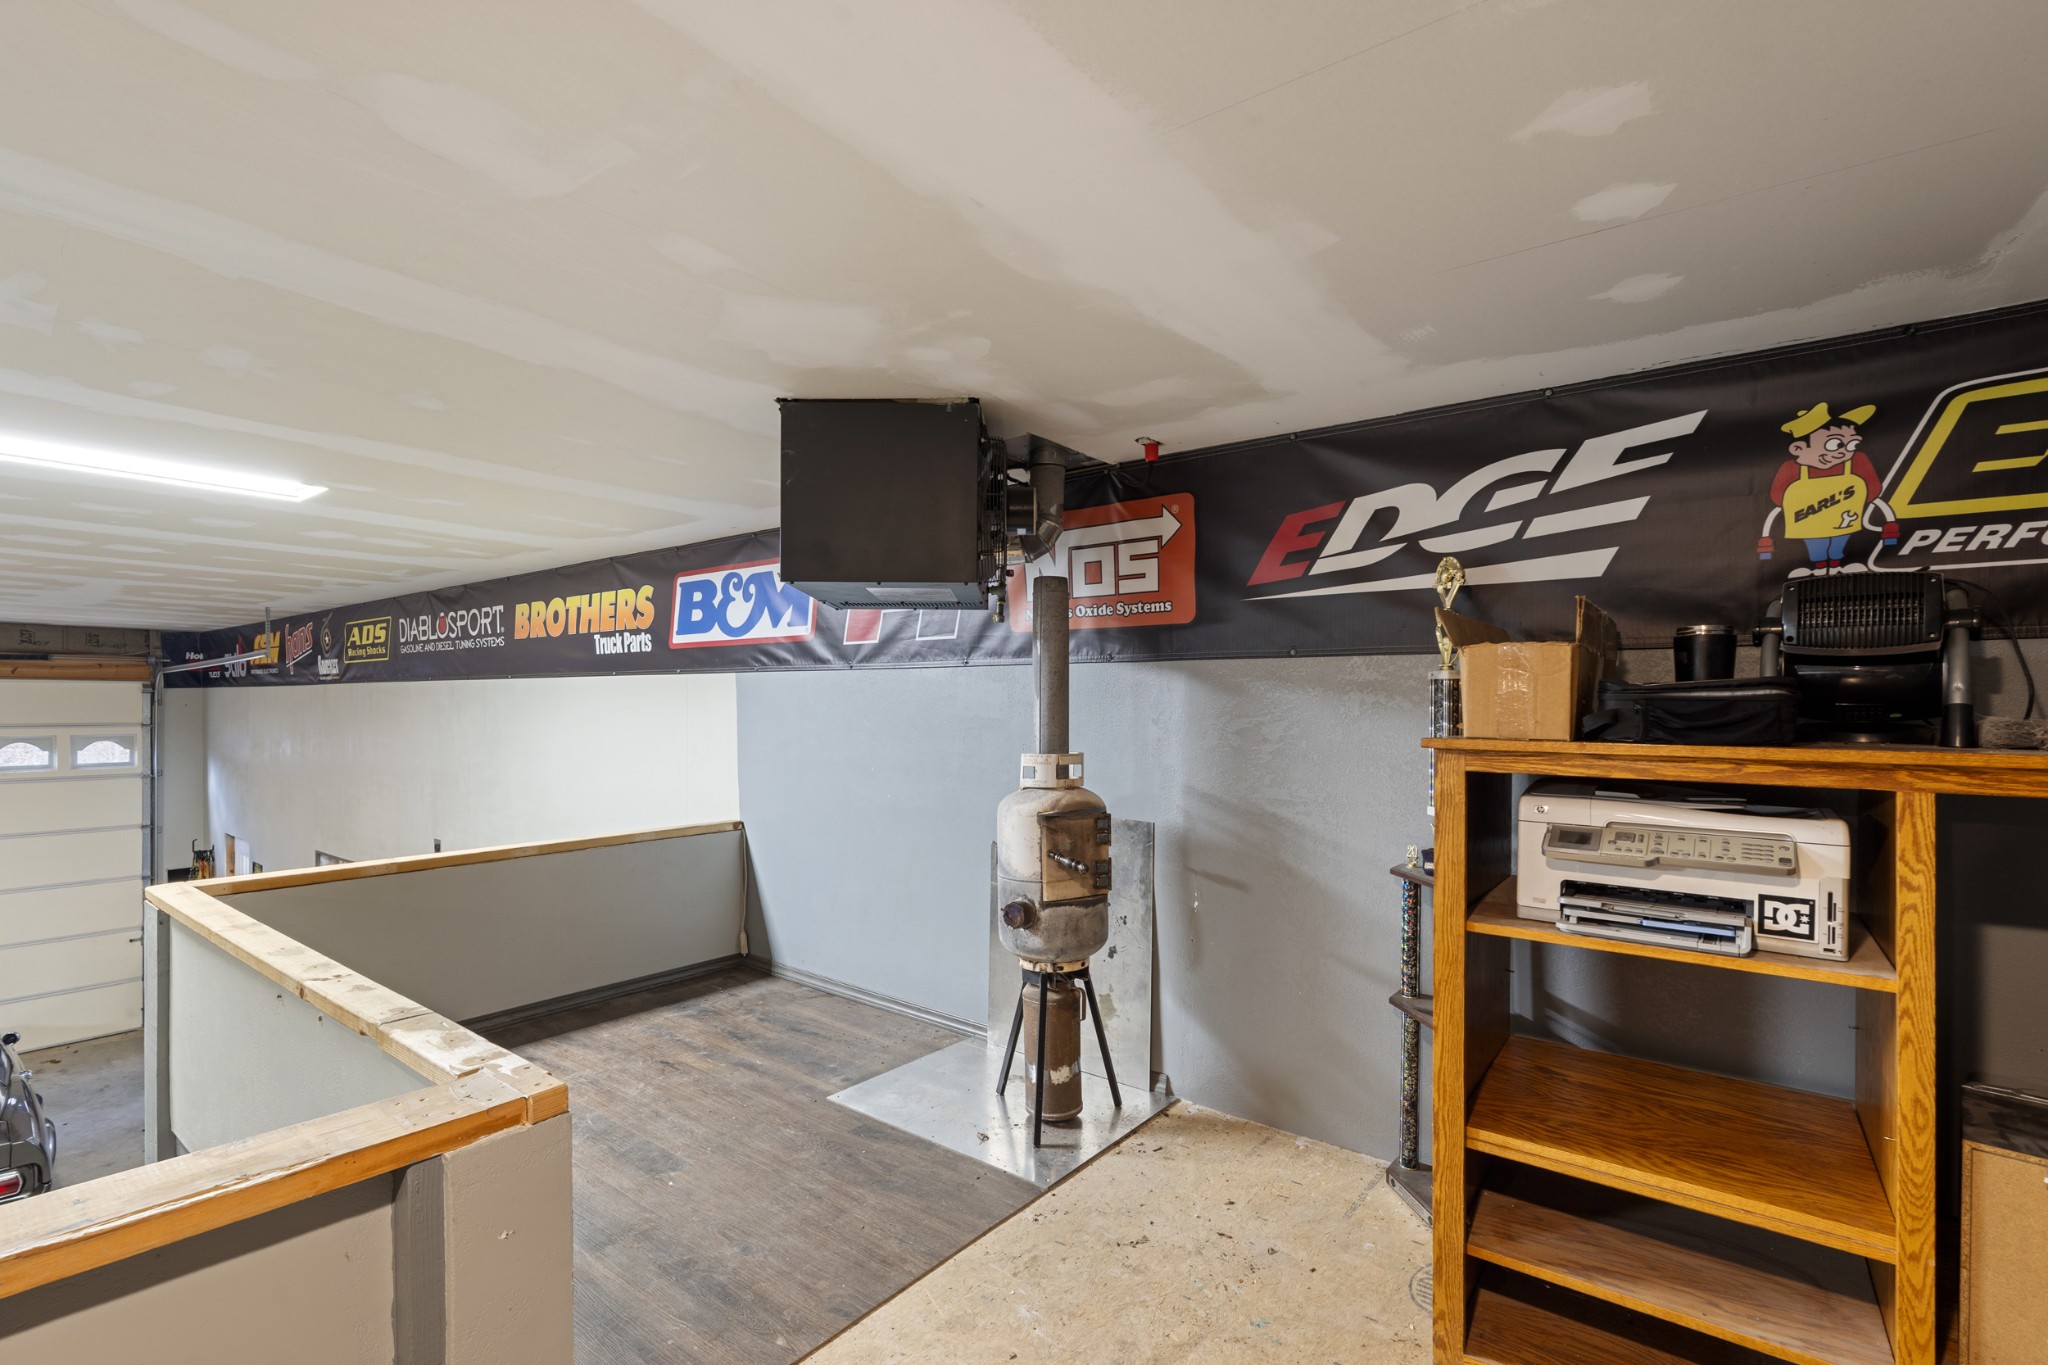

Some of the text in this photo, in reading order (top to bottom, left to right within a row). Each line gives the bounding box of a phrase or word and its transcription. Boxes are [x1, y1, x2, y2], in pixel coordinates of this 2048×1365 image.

[1246, 409, 1708, 587] EDGE
[1794, 485, 1856, 523] EARL'S
[1898, 519, 2048, 556] PERF
[514, 584, 655, 640] BROTHERS
[676, 571, 810, 638] B&M
[1075, 603, 1114, 618] Oxide
[1116, 601, 1172, 617] Systems
[347, 622, 387, 646] ADS
[399, 605, 504, 643] DIABLOSPORT
[348, 646, 386, 657] Racing Shocks
[400, 636, 505, 653] GASOLINE AND DIESEL TUNING SYSTEMS
[594, 631, 652, 655] Truck Parts
